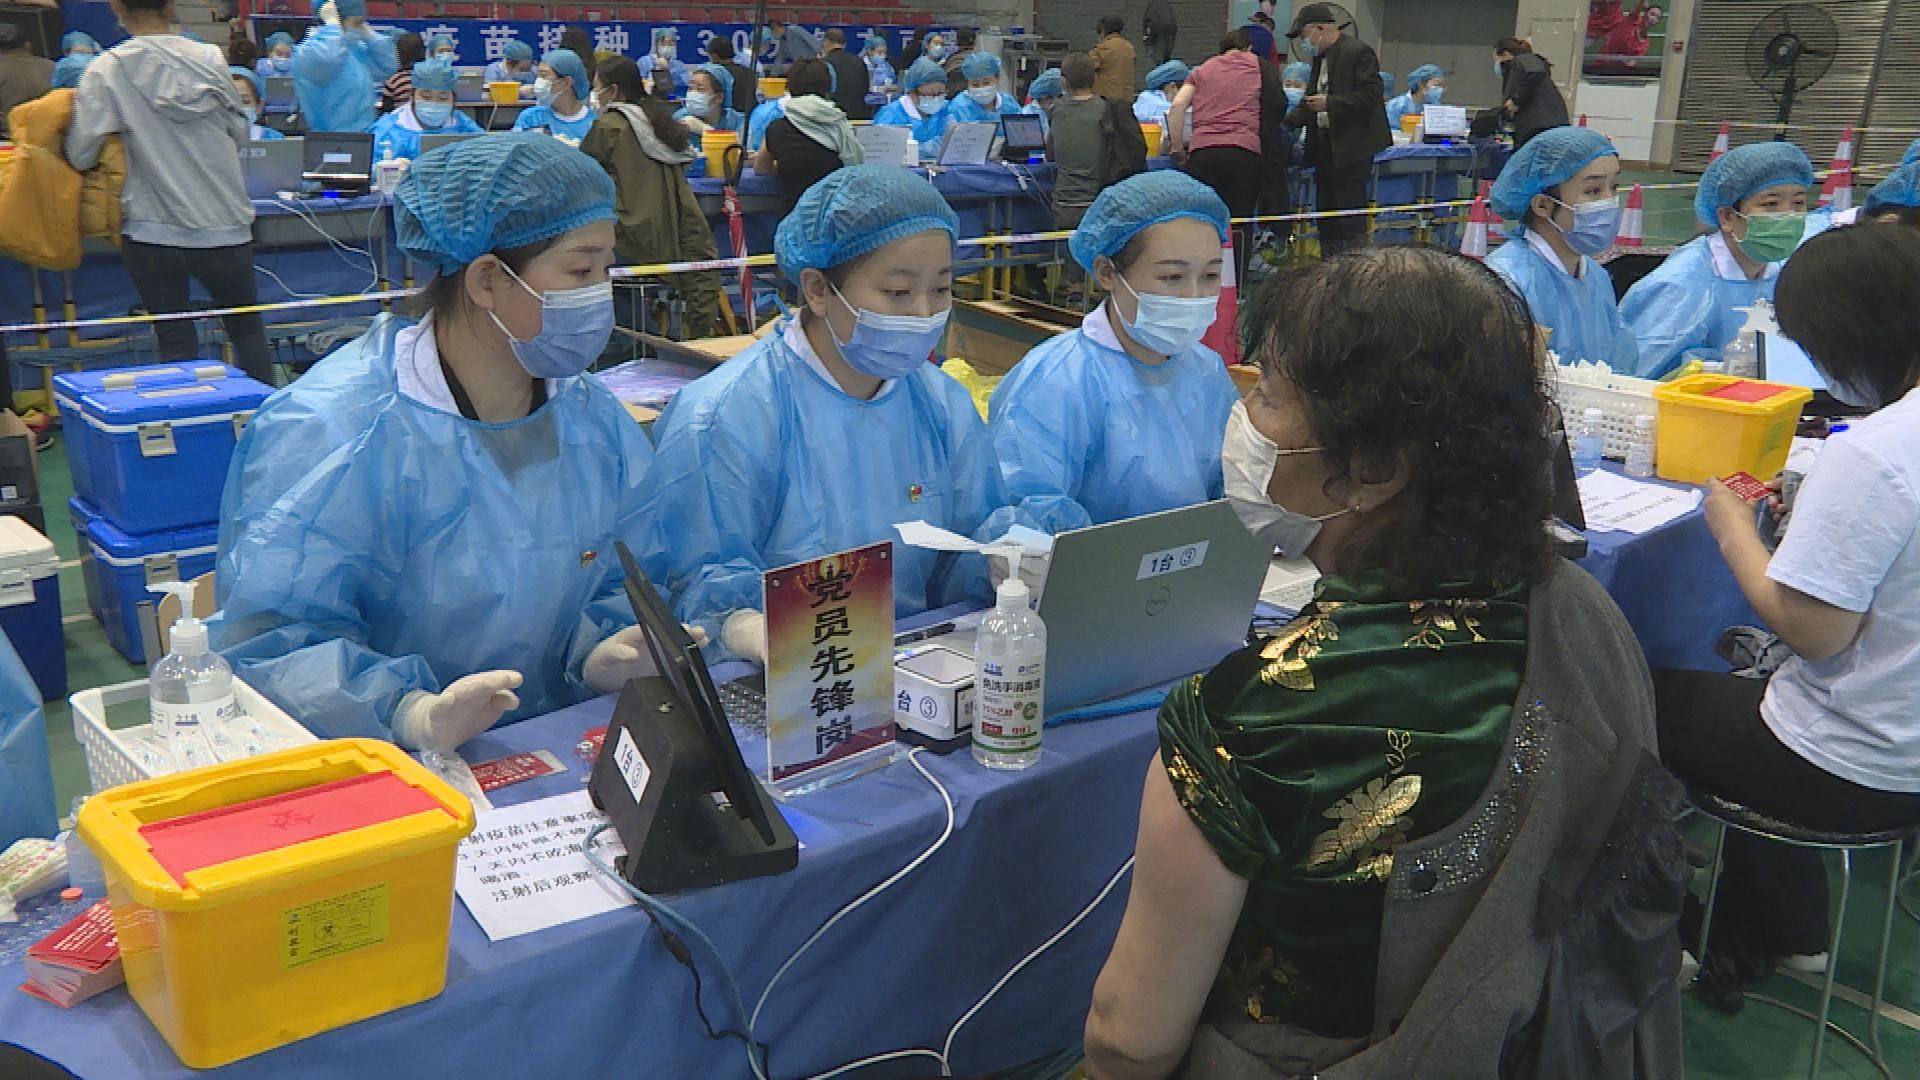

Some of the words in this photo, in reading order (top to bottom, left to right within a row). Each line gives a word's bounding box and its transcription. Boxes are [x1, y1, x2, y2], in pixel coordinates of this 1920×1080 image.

[808, 563, 855, 755] 党员先锋岗
[492, 867, 606, 903] 注射后观察
